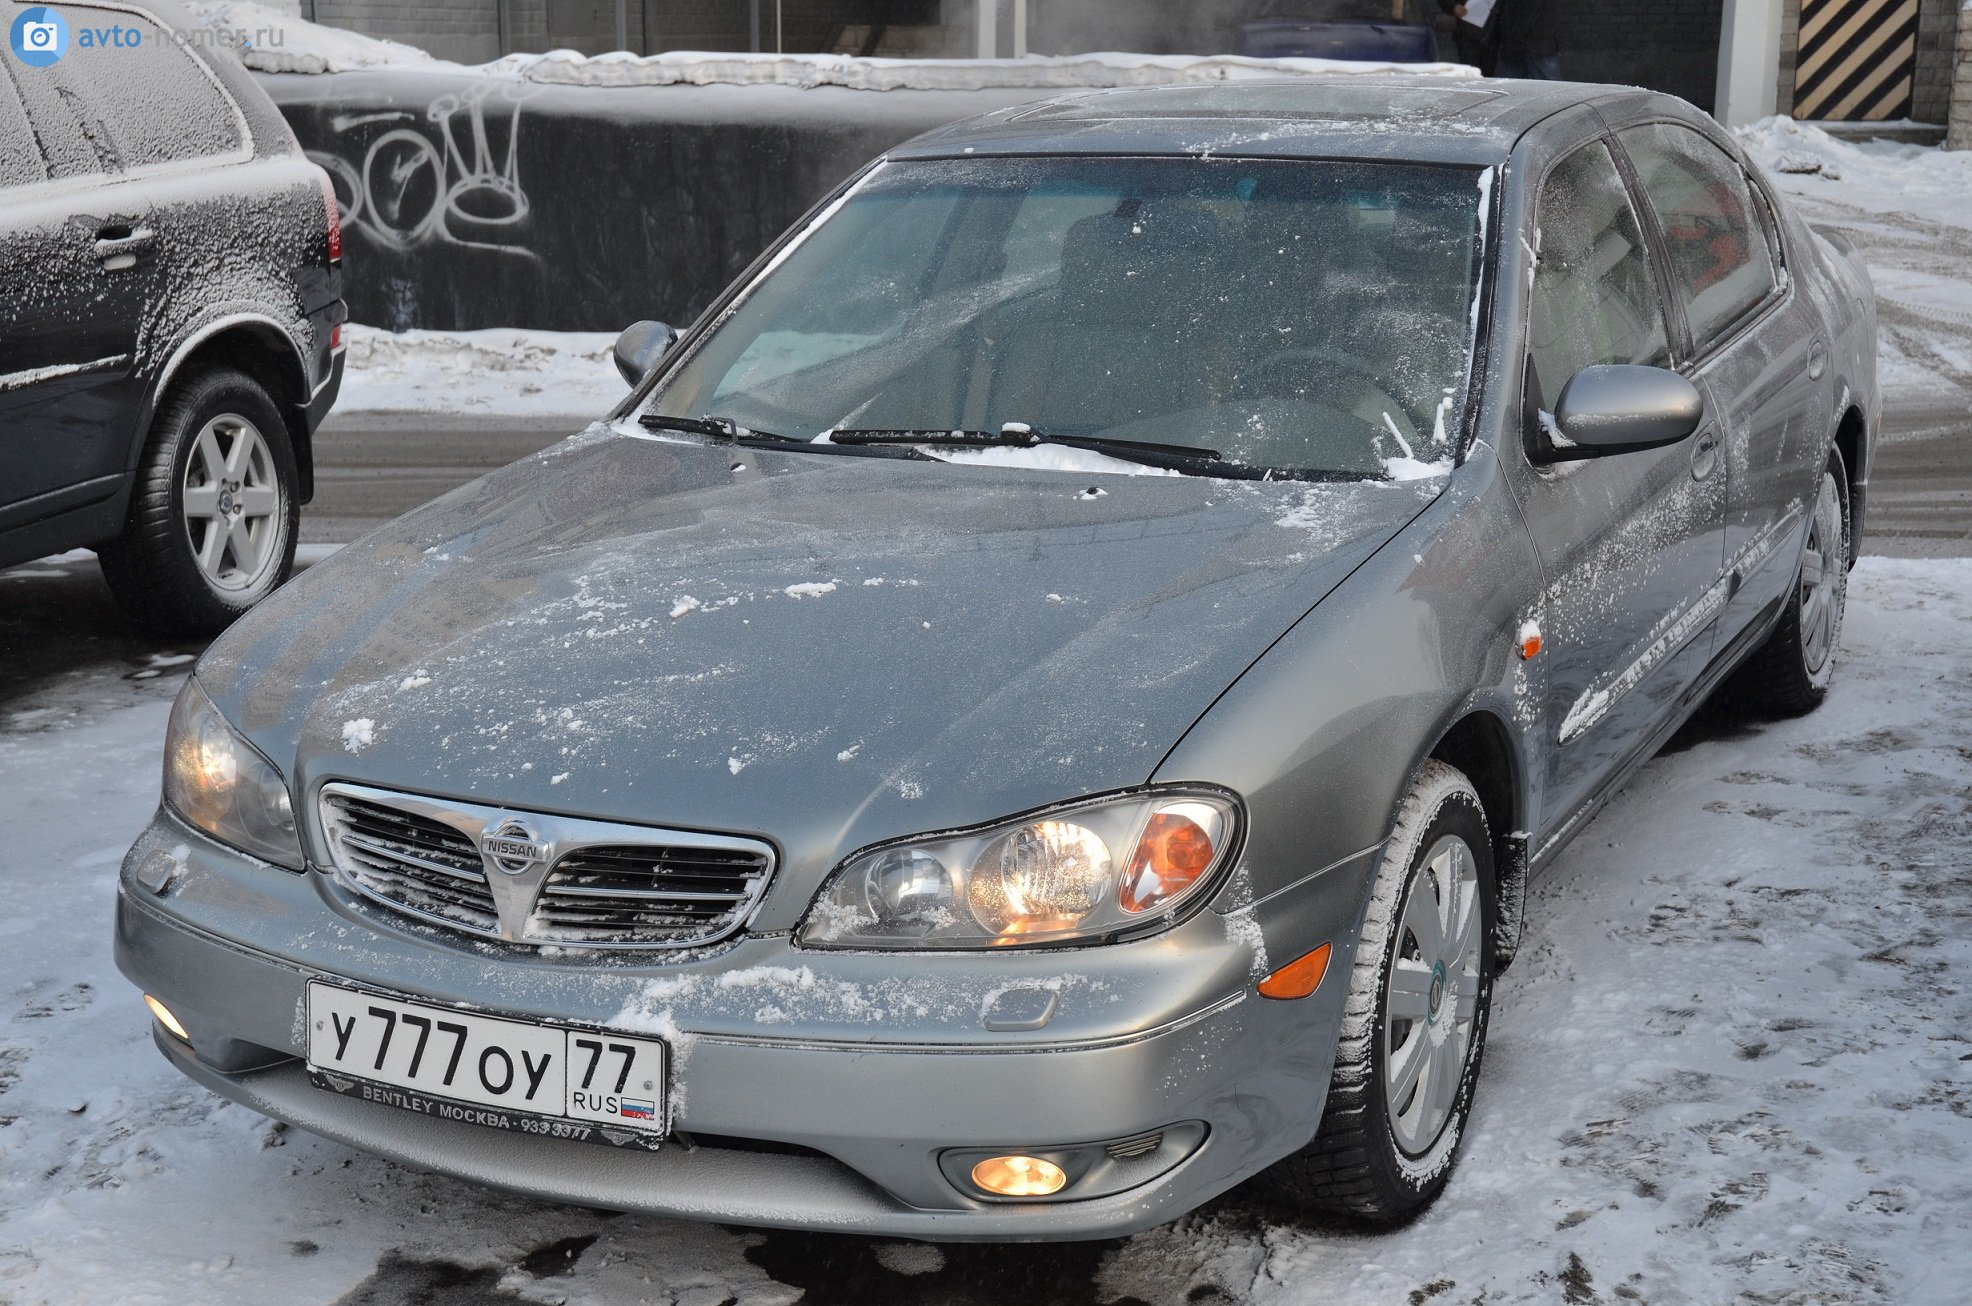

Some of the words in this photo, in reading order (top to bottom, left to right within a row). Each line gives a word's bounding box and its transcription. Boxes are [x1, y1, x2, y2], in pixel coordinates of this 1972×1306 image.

[488, 840, 537, 858] NISSAN
[575, 1039, 637, 1095] 77
[363, 1085, 434, 1114] BENTLEY
[440, 1104, 510, 1129] МОСКВА
[573, 1091, 618, 1115] RUS
